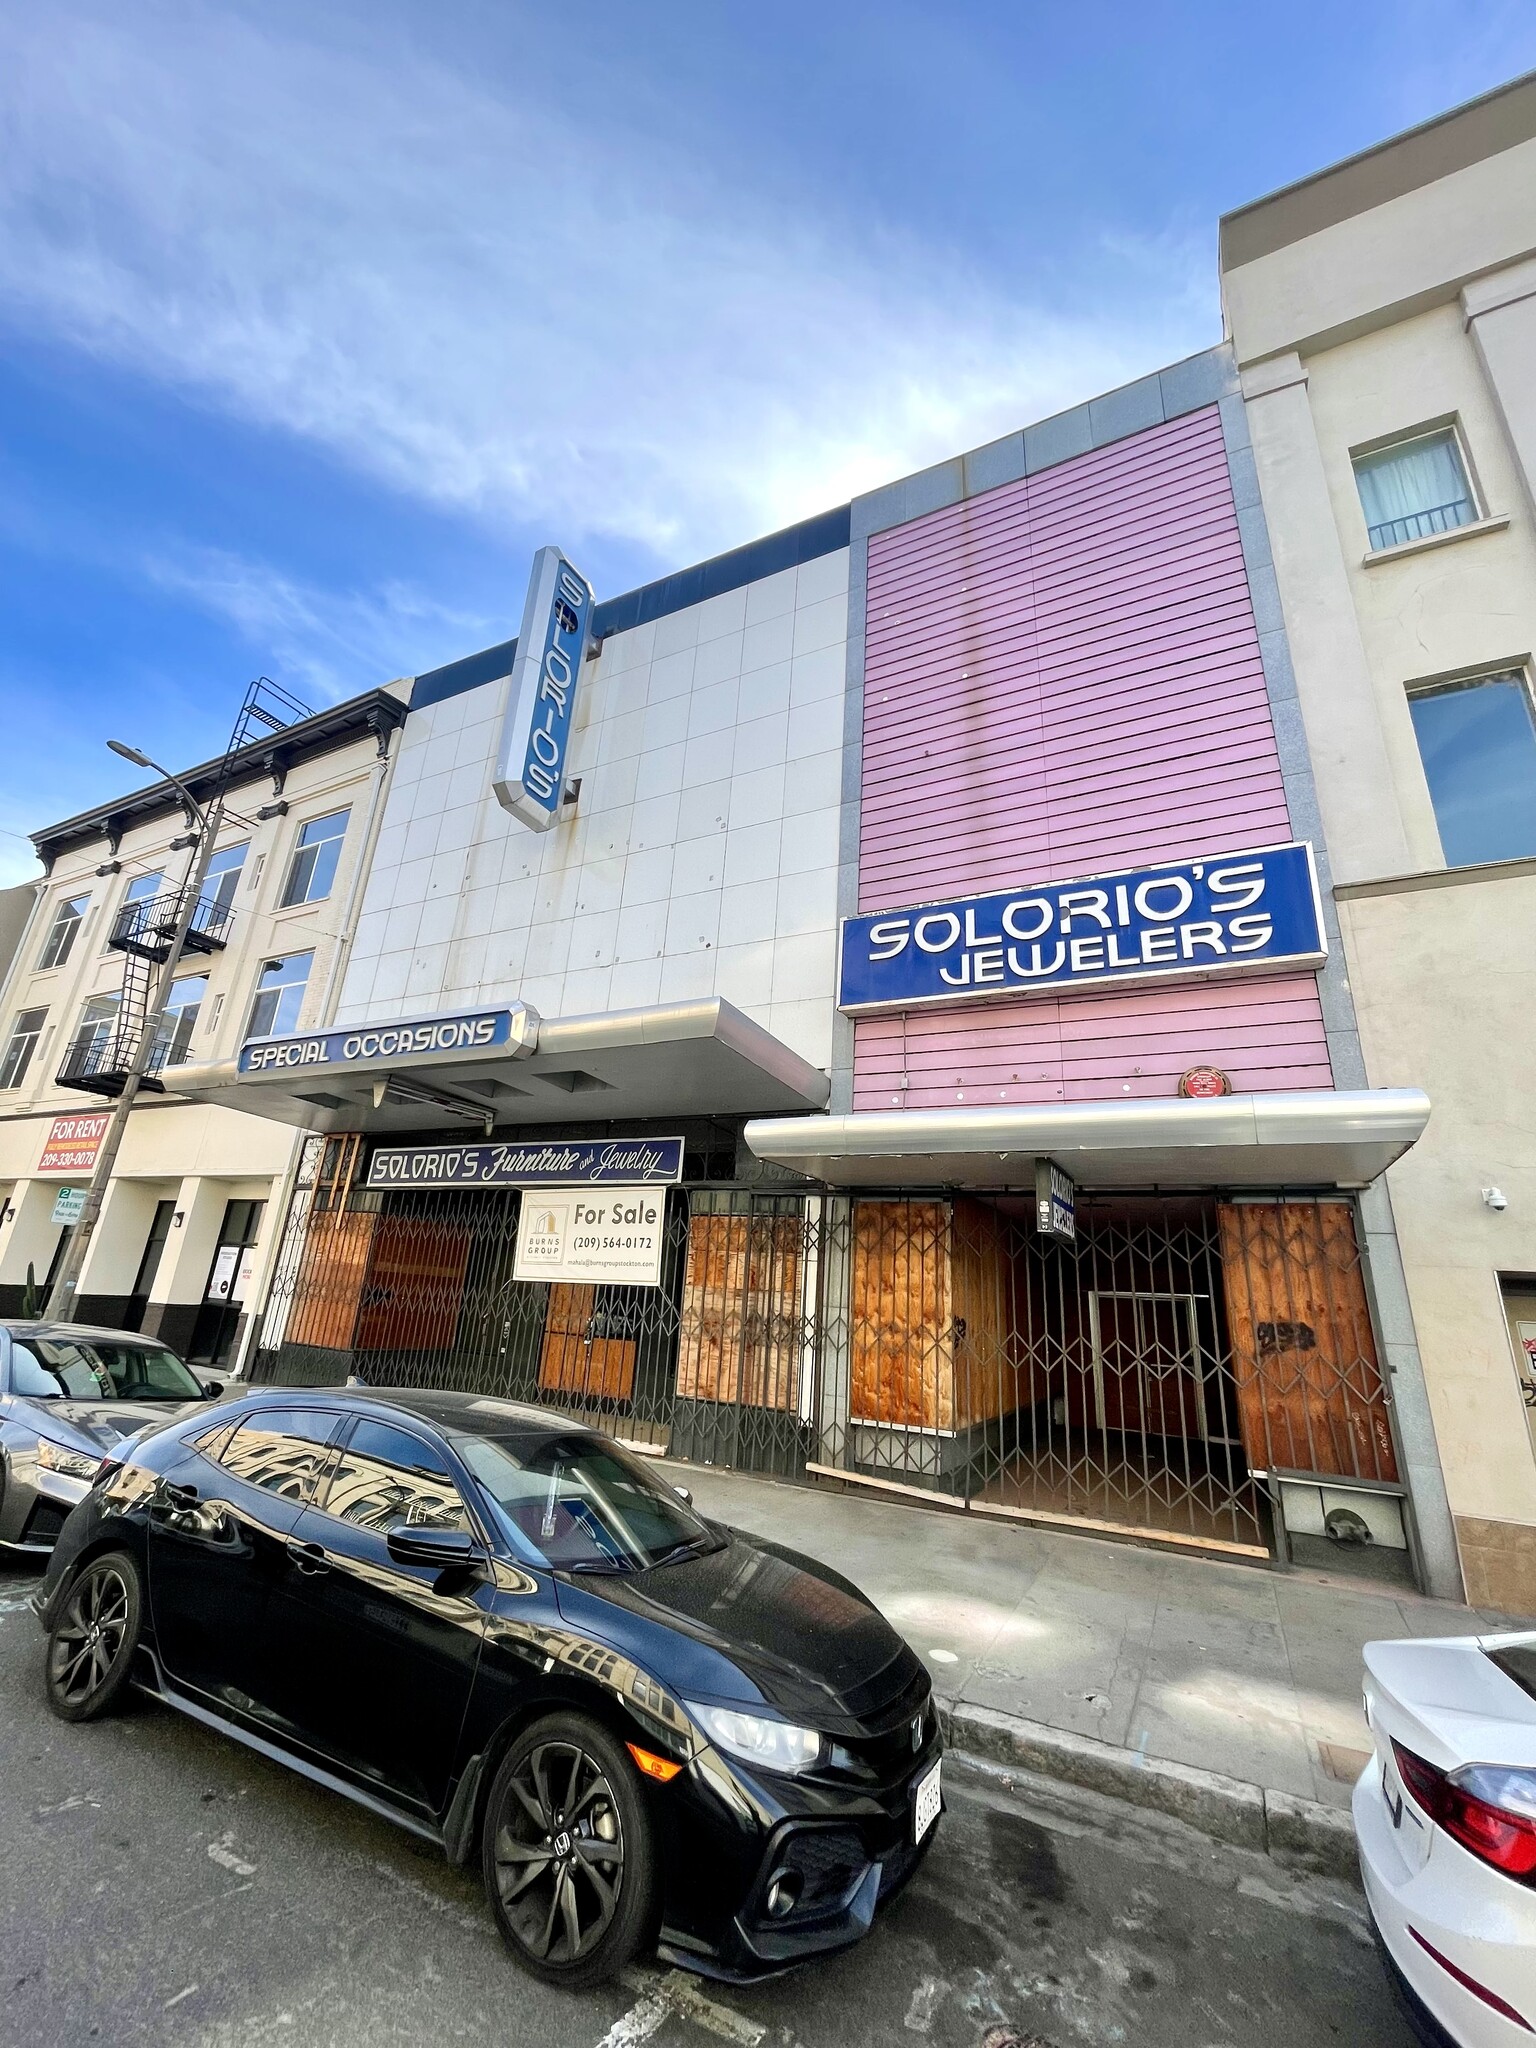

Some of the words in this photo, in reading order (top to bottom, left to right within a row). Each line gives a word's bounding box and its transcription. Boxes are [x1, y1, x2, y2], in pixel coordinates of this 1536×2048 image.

[526, 572, 584, 800] SLORIO'S
[869, 862, 1266, 961] SOLORIO'S
[939, 912, 1273, 986] JEWELERS
[248, 1040, 329, 1070] SPECIAL
[343, 1019, 496, 1060] OCCASIONS
[51, 1121, 75, 1139] FOR
[74, 1118, 107, 1138] RENT
[40, 1152, 95, 1167] 209-330-0078
[373, 1148, 479, 1180] SOLORIO'S
[481, 1146, 581, 1181] Furniture
[579, 1149, 595, 1170] and
[590, 1143, 677, 1181] Jewelry
[60, 1189, 70, 1198] 2
[574, 1203, 605, 1225] For
[612, 1200, 657, 1225] Sale
[528, 1247, 559, 1255] GROUP
[529, 1238, 560, 1246] BURNS
[574, 1236, 601, 1251] (209)
[603, 1237, 652, 1250] 564-0172
